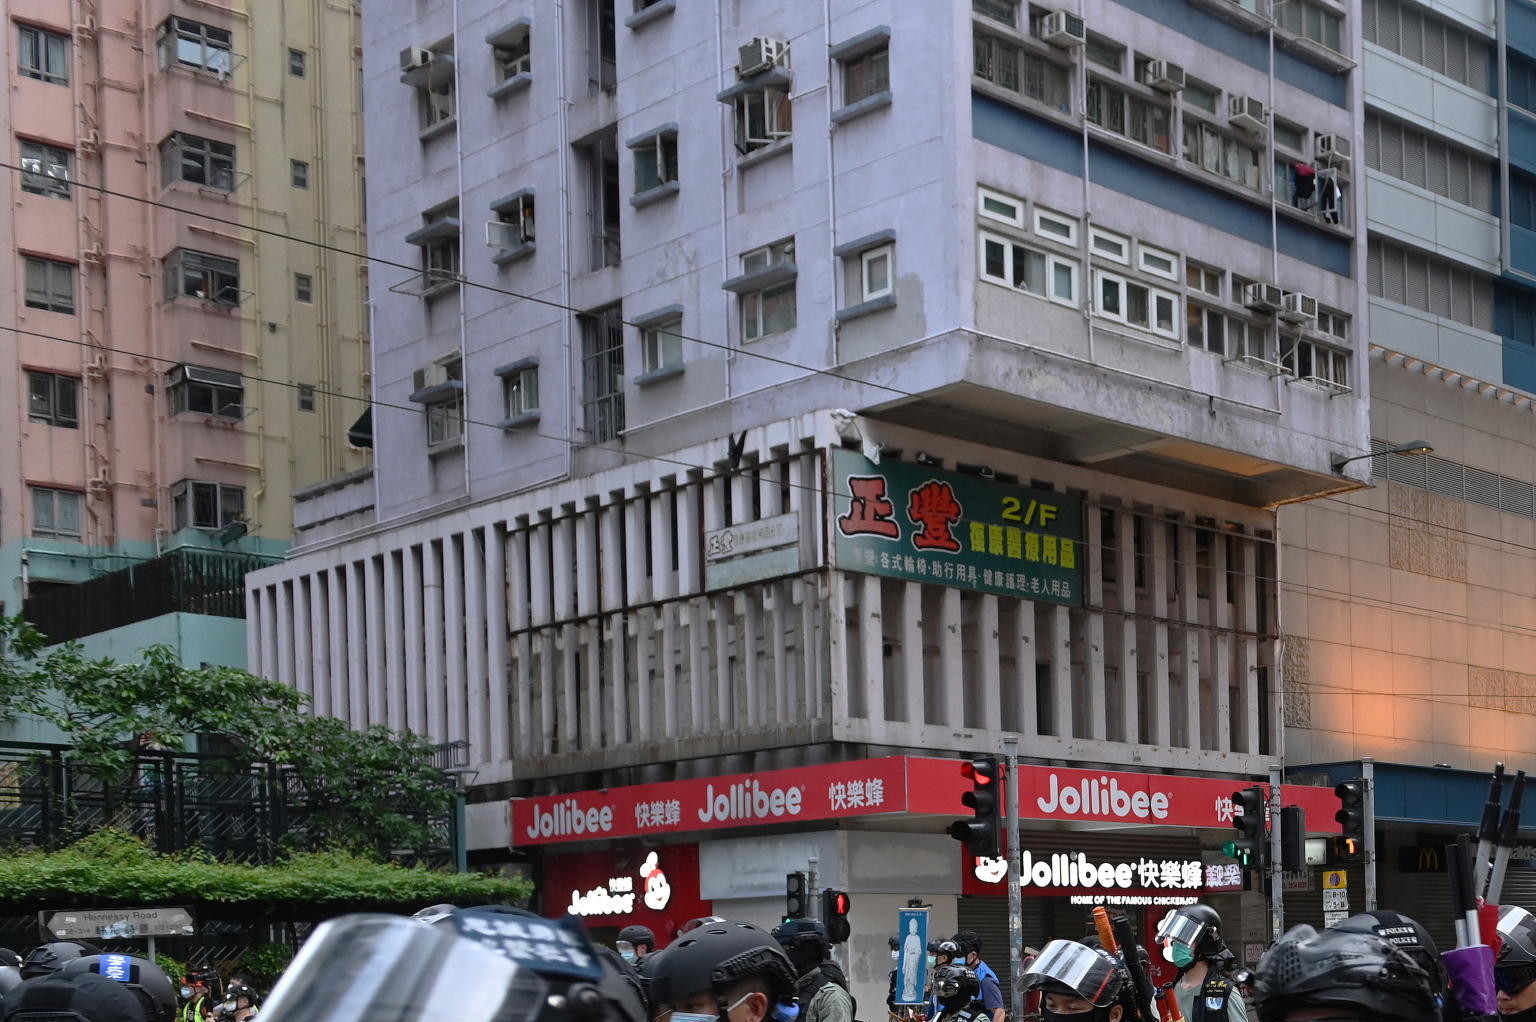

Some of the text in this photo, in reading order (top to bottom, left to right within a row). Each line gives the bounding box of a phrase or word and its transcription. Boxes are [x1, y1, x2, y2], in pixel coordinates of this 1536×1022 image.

[838, 475, 963, 553] 正豐
[1002, 496, 1058, 527] 2/F
[698, 779, 801, 823] Jollibee
[829, 778, 884, 811] 快樂蜂
[1038, 773, 1169, 818] Jollibee
[527, 800, 613, 839] Jollibee
[635, 799, 681, 829] 快樂蜂
[1020, 850, 1133, 889] Jollibee
[1138, 857, 1202, 889] 快樂蜂
[84, 911, 158, 921] Hennessy Road
